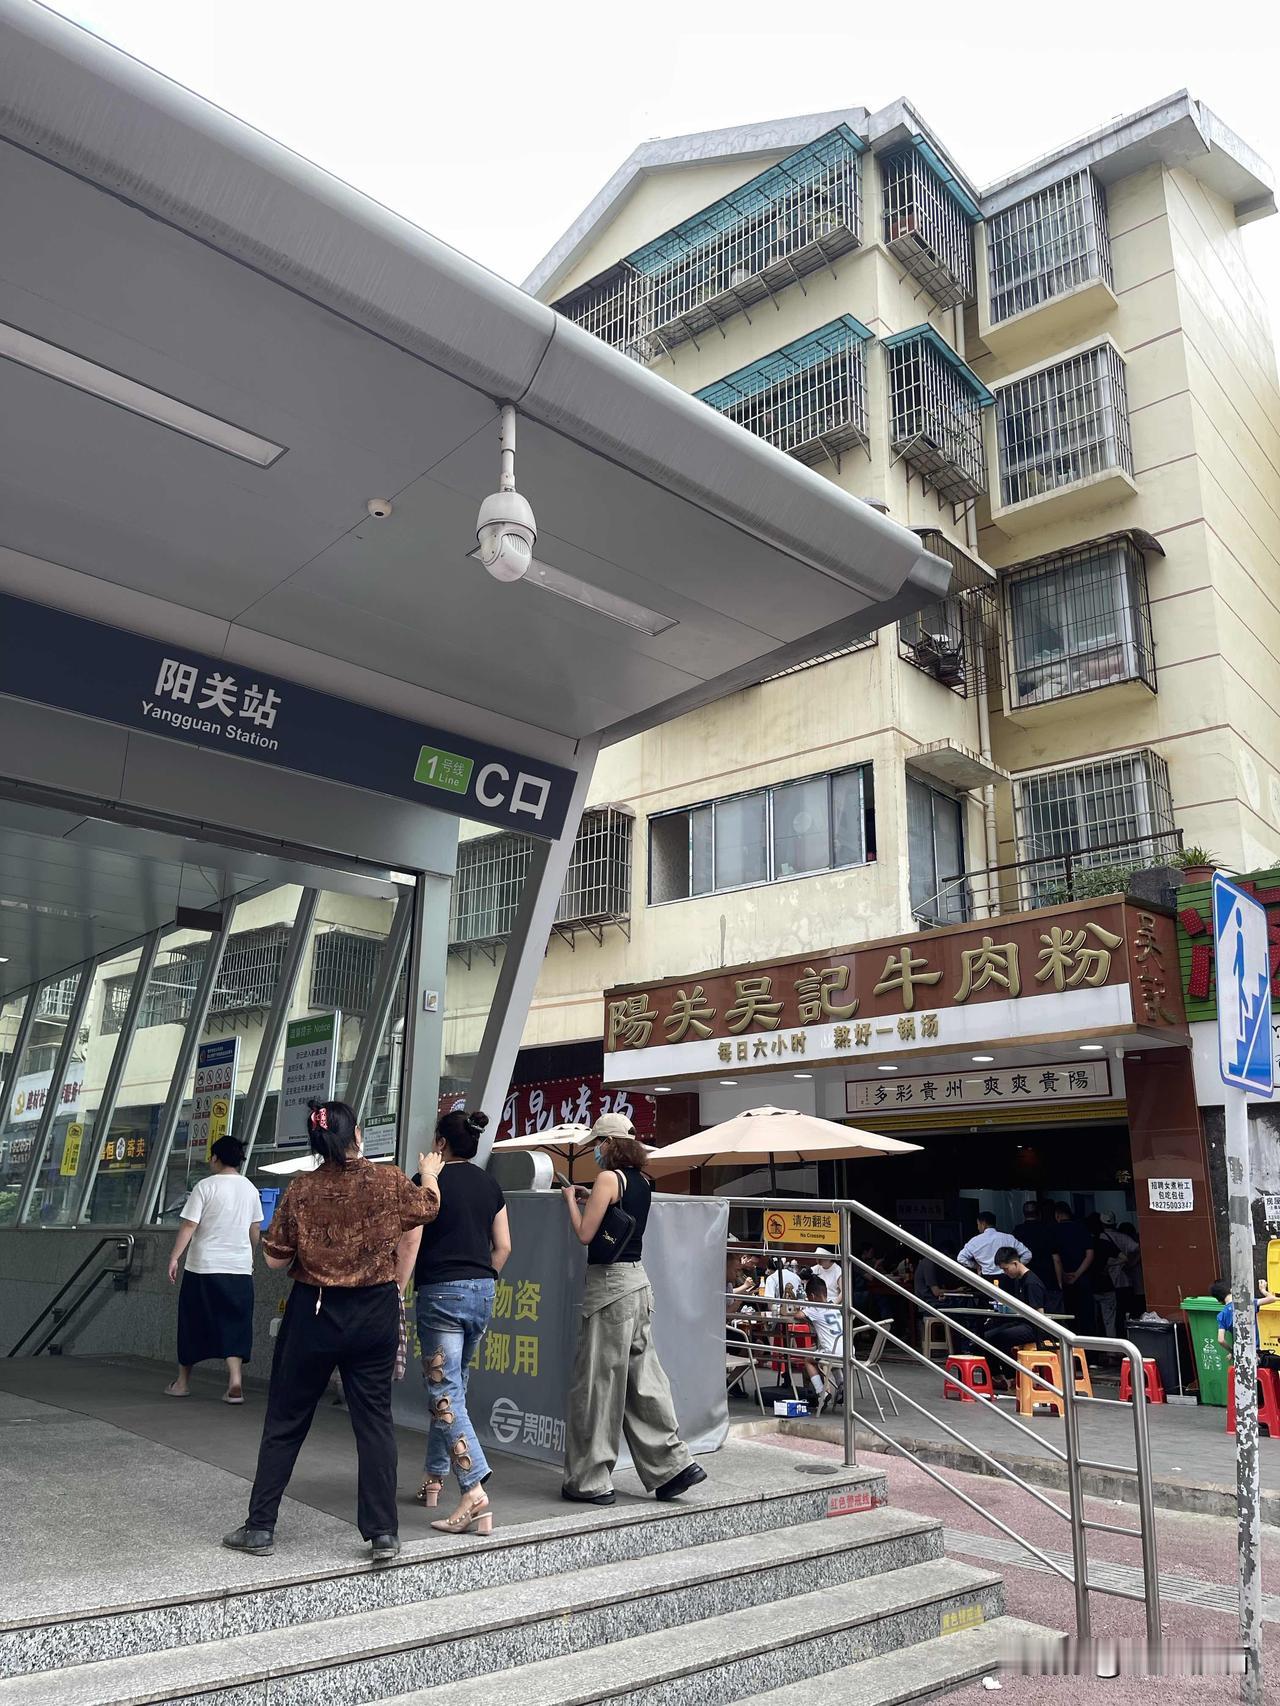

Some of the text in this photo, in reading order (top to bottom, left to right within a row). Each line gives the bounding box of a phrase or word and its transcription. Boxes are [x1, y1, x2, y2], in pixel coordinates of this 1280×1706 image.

[155, 658, 282, 729] 阳关站
[142, 700, 279, 751] Yangguan Station
[439, 773, 460, 787] Line
[475, 763, 552, 821] C口
[717, 1013, 939, 1063] 每日六小时 熬好一锅汤
[1158, 1191, 1185, 1200] 包吃包住
[792, 1214, 832, 1229] 请勿翻越
